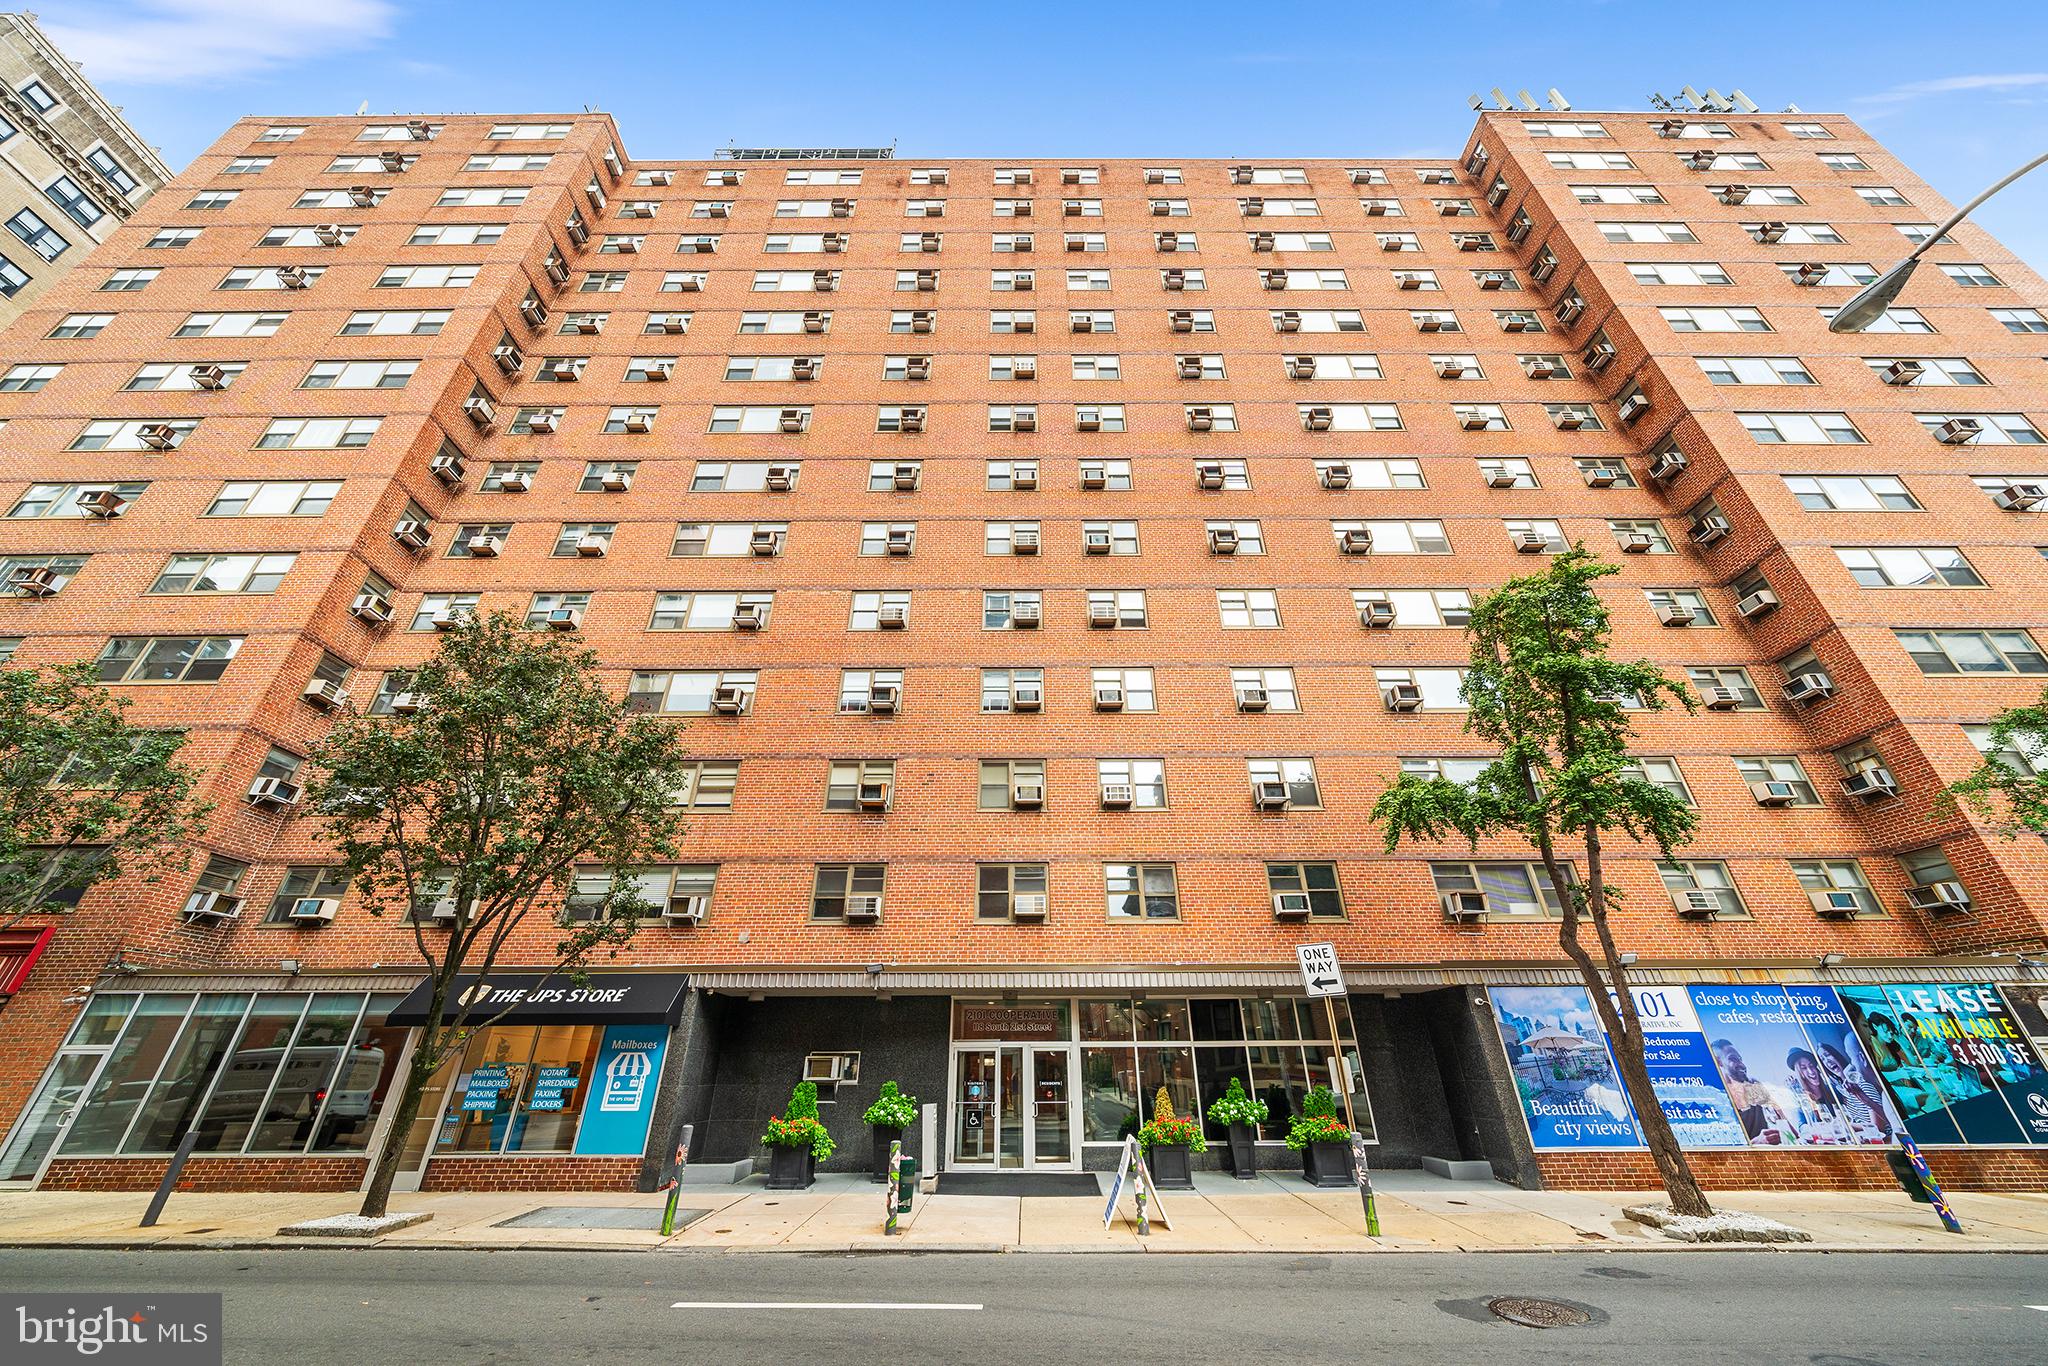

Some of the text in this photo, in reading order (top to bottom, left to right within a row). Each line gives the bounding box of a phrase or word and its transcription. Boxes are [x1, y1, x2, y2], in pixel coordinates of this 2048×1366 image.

[1303, 948, 1331, 960] ONE
[1305, 961, 1333, 974] WAY
[488, 989, 528, 1003] THE
[526, 989, 567, 1003] UPS
[565, 989, 628, 1003] STORE
[1695, 991, 1828, 1011] close to shopping,
[1895, 989, 2003, 1013] LEASE
[966, 1010, 1060, 1020] 2101 COOPERATIVE
[1717, 1008, 1846, 1026] cafes, restaurants
[985, 1022, 1009, 1032] South
[1009, 1022, 1027, 1032] 21st
[1027, 1022, 1053, 1032] Street
[1916, 1017, 2020, 1039] AVAILABLE
[611, 1040, 658, 1049] Mailboxes
[1659, 1050, 1681, 1060] Sale
[1952, 1043, 2032, 1066] 3,500 SF
[473, 1069, 507, 1077] PRINTING
[540, 1069, 569, 1077] NOTARY
[470, 1079, 510, 1087] MAILBOXES
[537, 1079, 578, 1087] SHREDDING
[1650, 1076, 1704, 1088] 5.567.1780
[466, 1090, 498, 1098] PACKING
[463, 1101, 497, 1109] SHIPPING
[531, 1100, 563, 1108] LOCKERS
[1530, 1099, 1602, 1116] Beautiful
[1663, 1106, 1720, 1119] sit us at
[1554, 1120, 1632, 1140] city views
